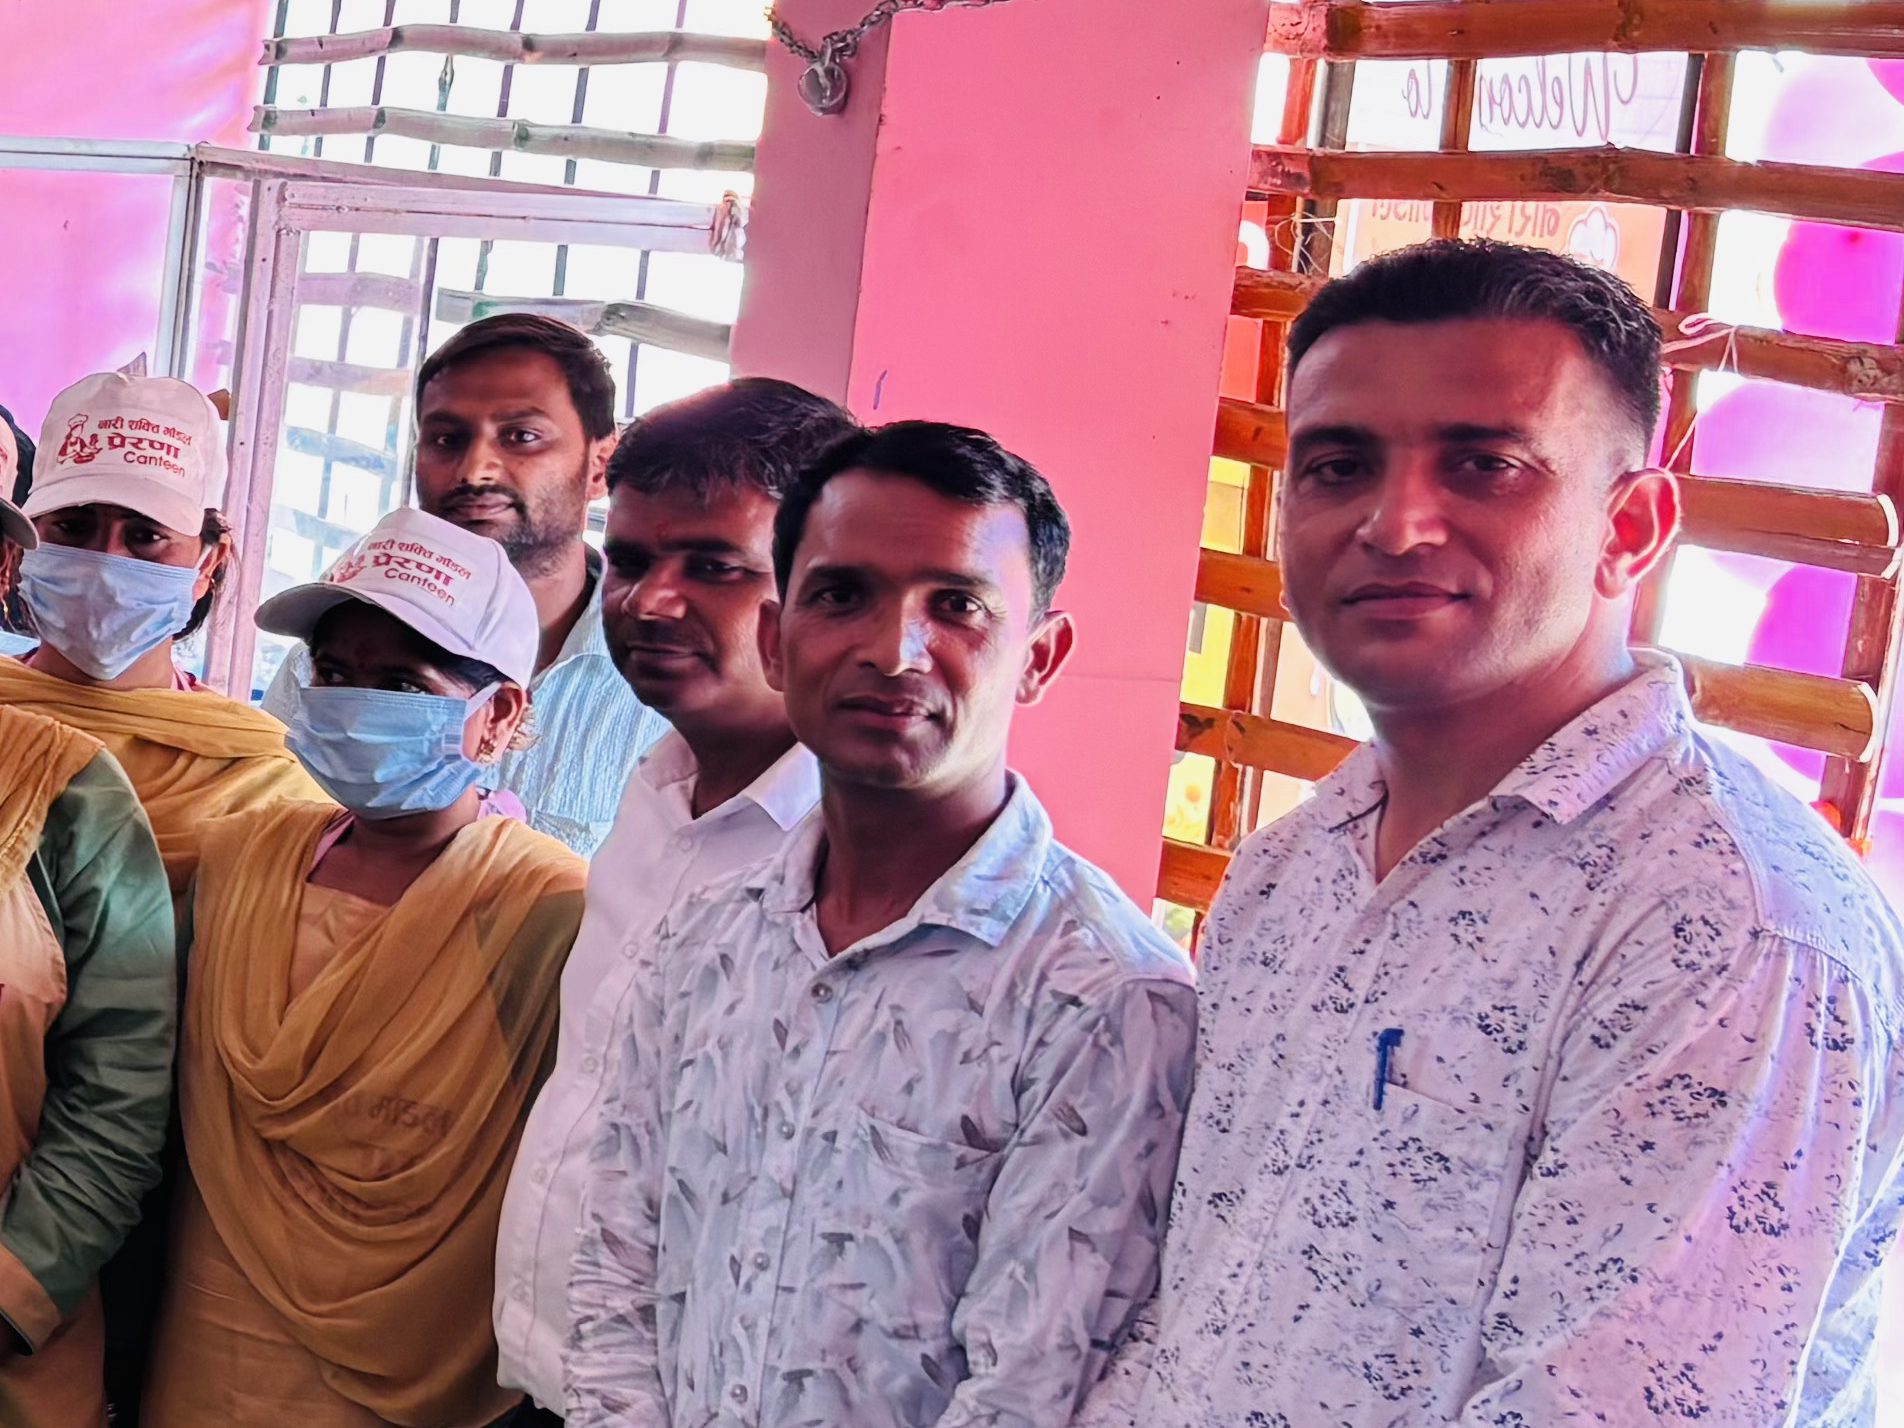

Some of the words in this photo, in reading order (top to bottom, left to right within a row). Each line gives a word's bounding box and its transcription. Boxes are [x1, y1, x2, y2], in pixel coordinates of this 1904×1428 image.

[107, 433, 180, 459] प्रेरणा
[124, 451, 185, 477] Canteen
[372, 553, 454, 586] प्रेरणा
[384, 568, 455, 607] Canteen
